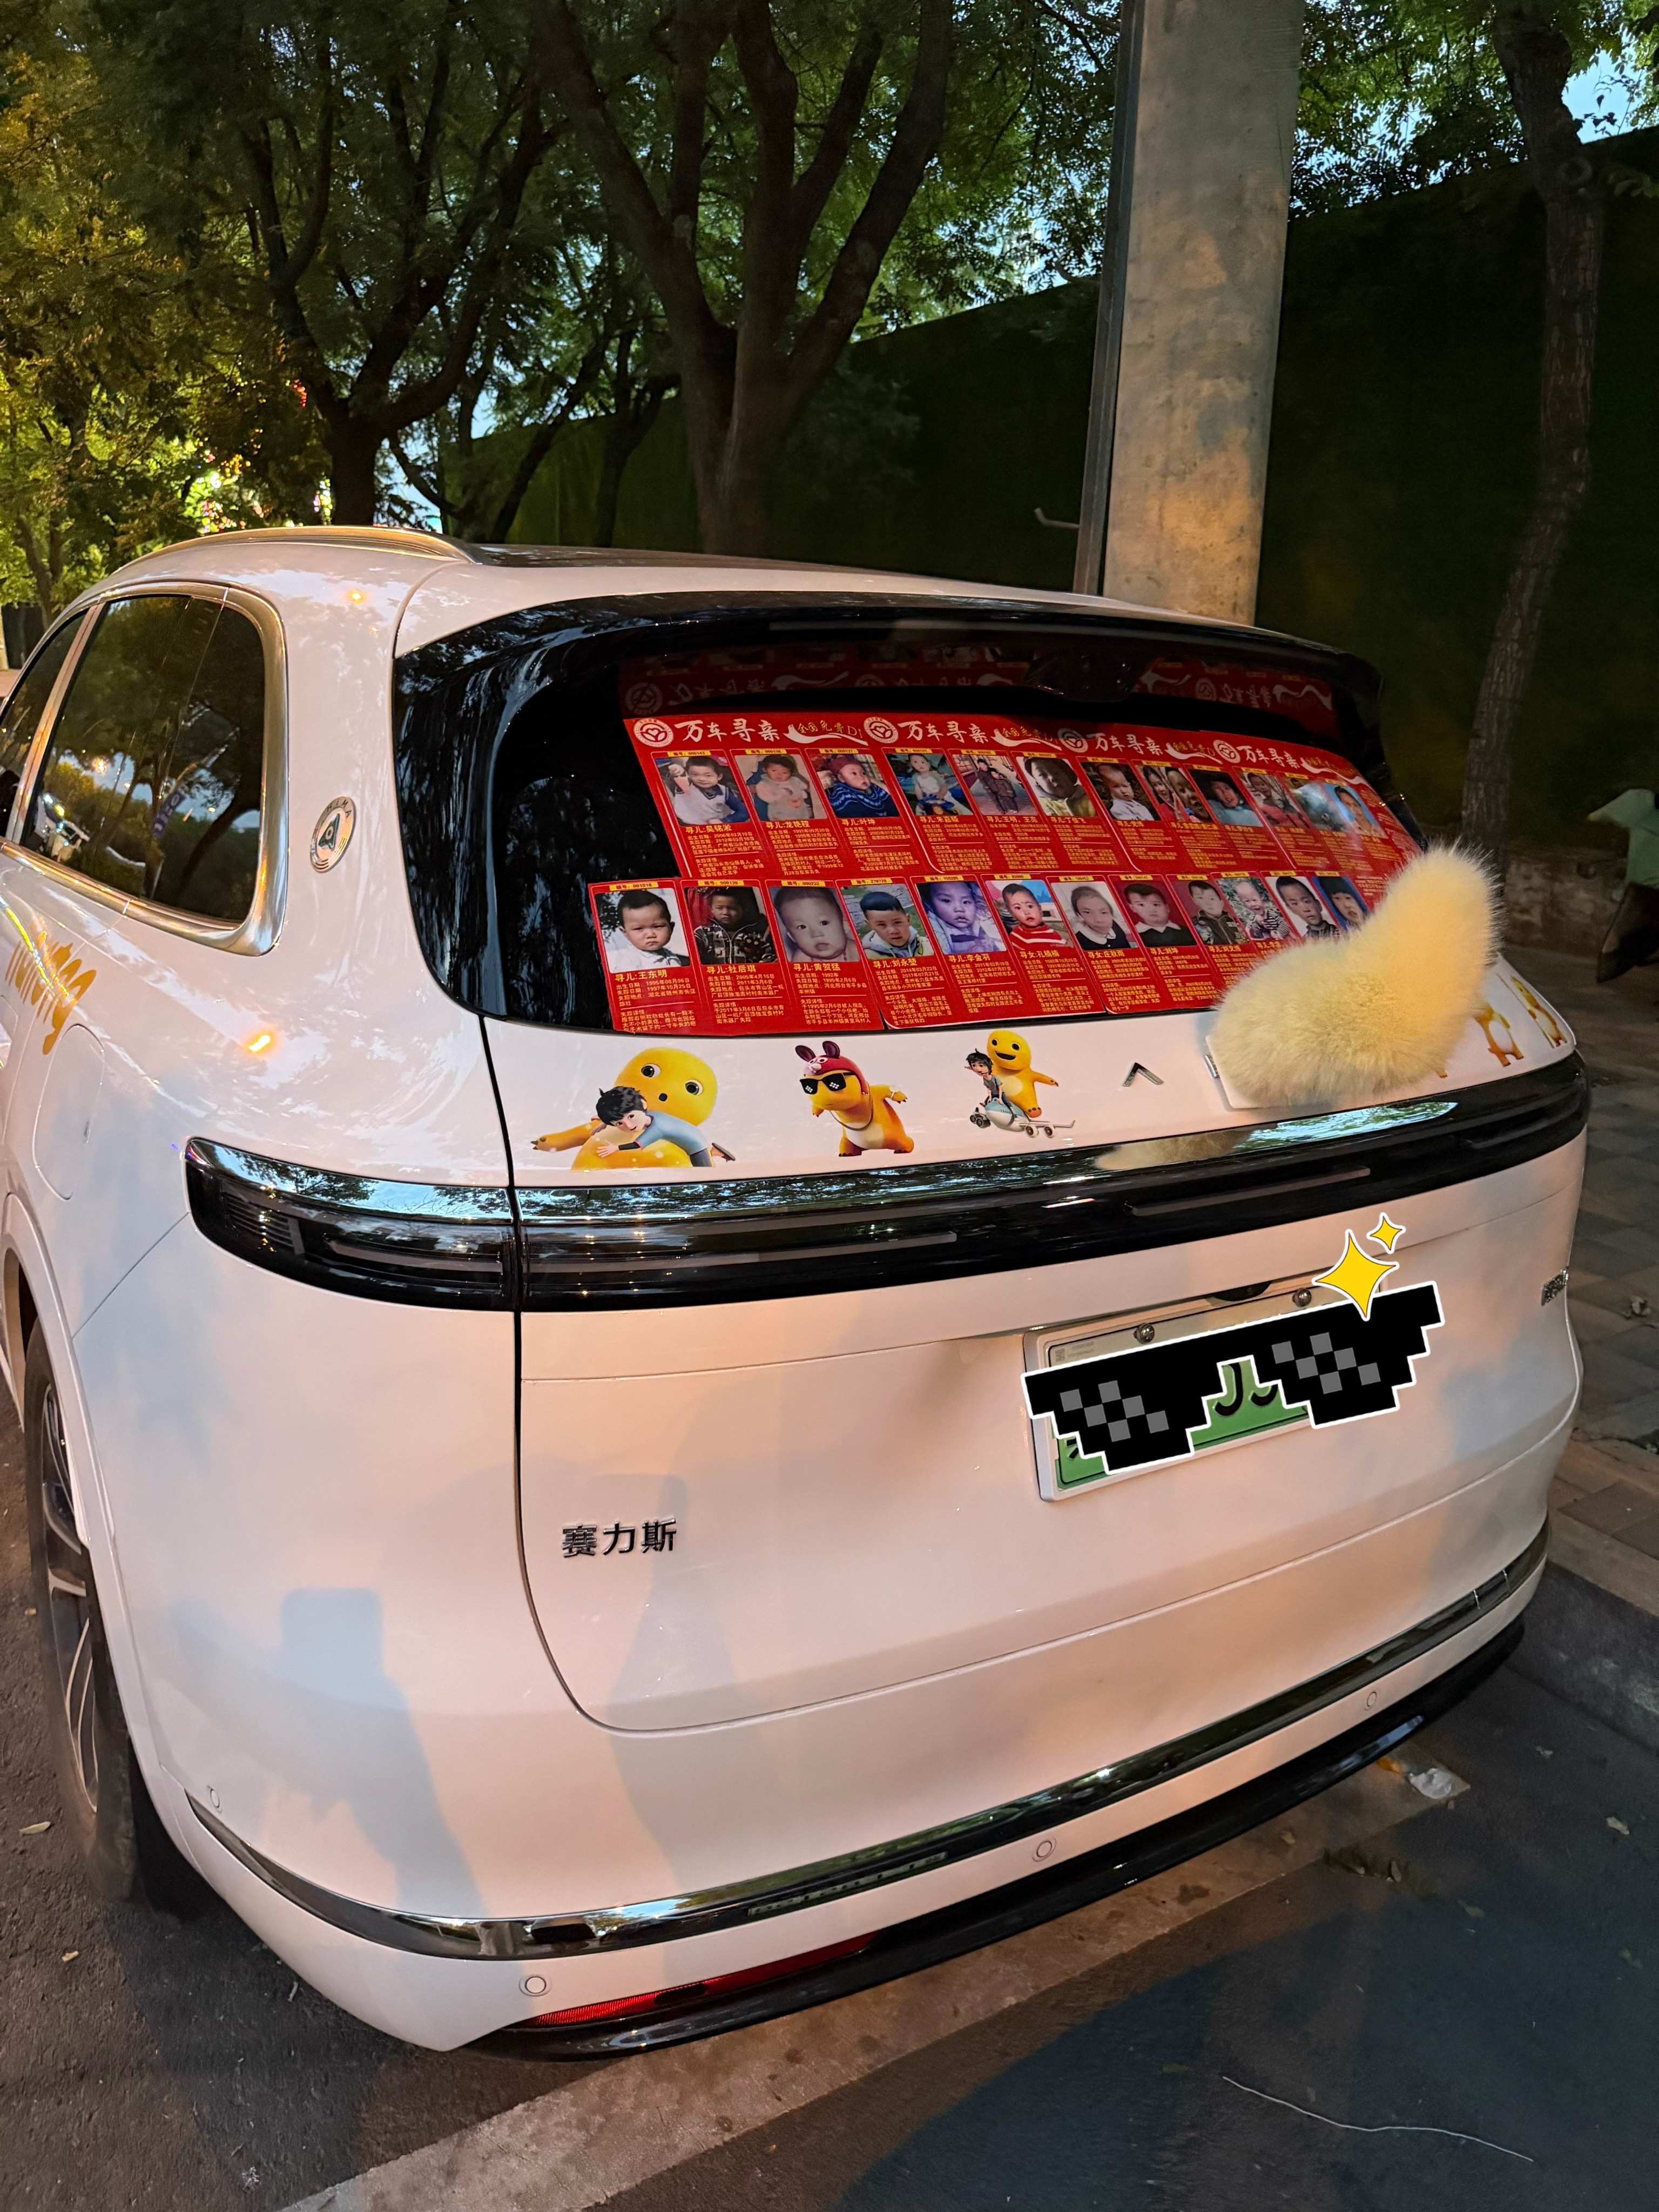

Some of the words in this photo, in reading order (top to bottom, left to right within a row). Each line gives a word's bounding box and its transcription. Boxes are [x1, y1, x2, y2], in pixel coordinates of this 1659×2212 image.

[674, 718, 780, 743] 万车寻亲
[897, 720, 989, 744] 万车寻亲
[1086, 732, 1163, 756] 万车寻亲
[1236, 745, 1300, 769] 万车寻亲
[615, 969, 667, 982] 寻儿:王东明
[562, 1518, 677, 1558] 赛力斯
